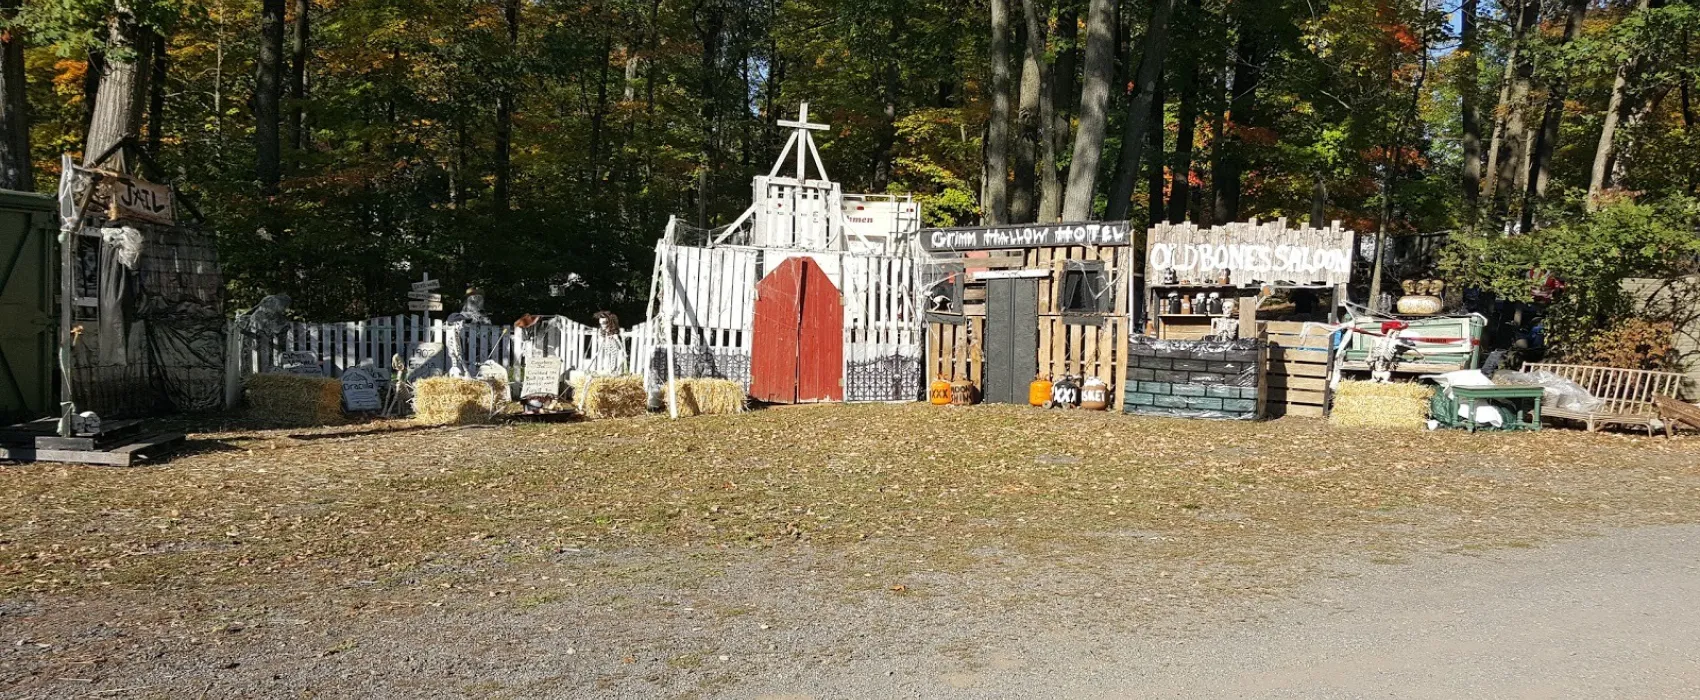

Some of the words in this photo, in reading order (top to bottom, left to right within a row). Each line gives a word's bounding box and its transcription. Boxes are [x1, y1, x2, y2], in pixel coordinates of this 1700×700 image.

[121, 181, 165, 213] JAIL
[984, 228, 1049, 246] HALLOW
[1055, 225, 1124, 243] HOTEL
[1150, 243, 1197, 270] OLD
[1198, 244, 1271, 272] BONES
[1273, 246, 1352, 272] SALOON
[932, 388, 949, 398] XXX
